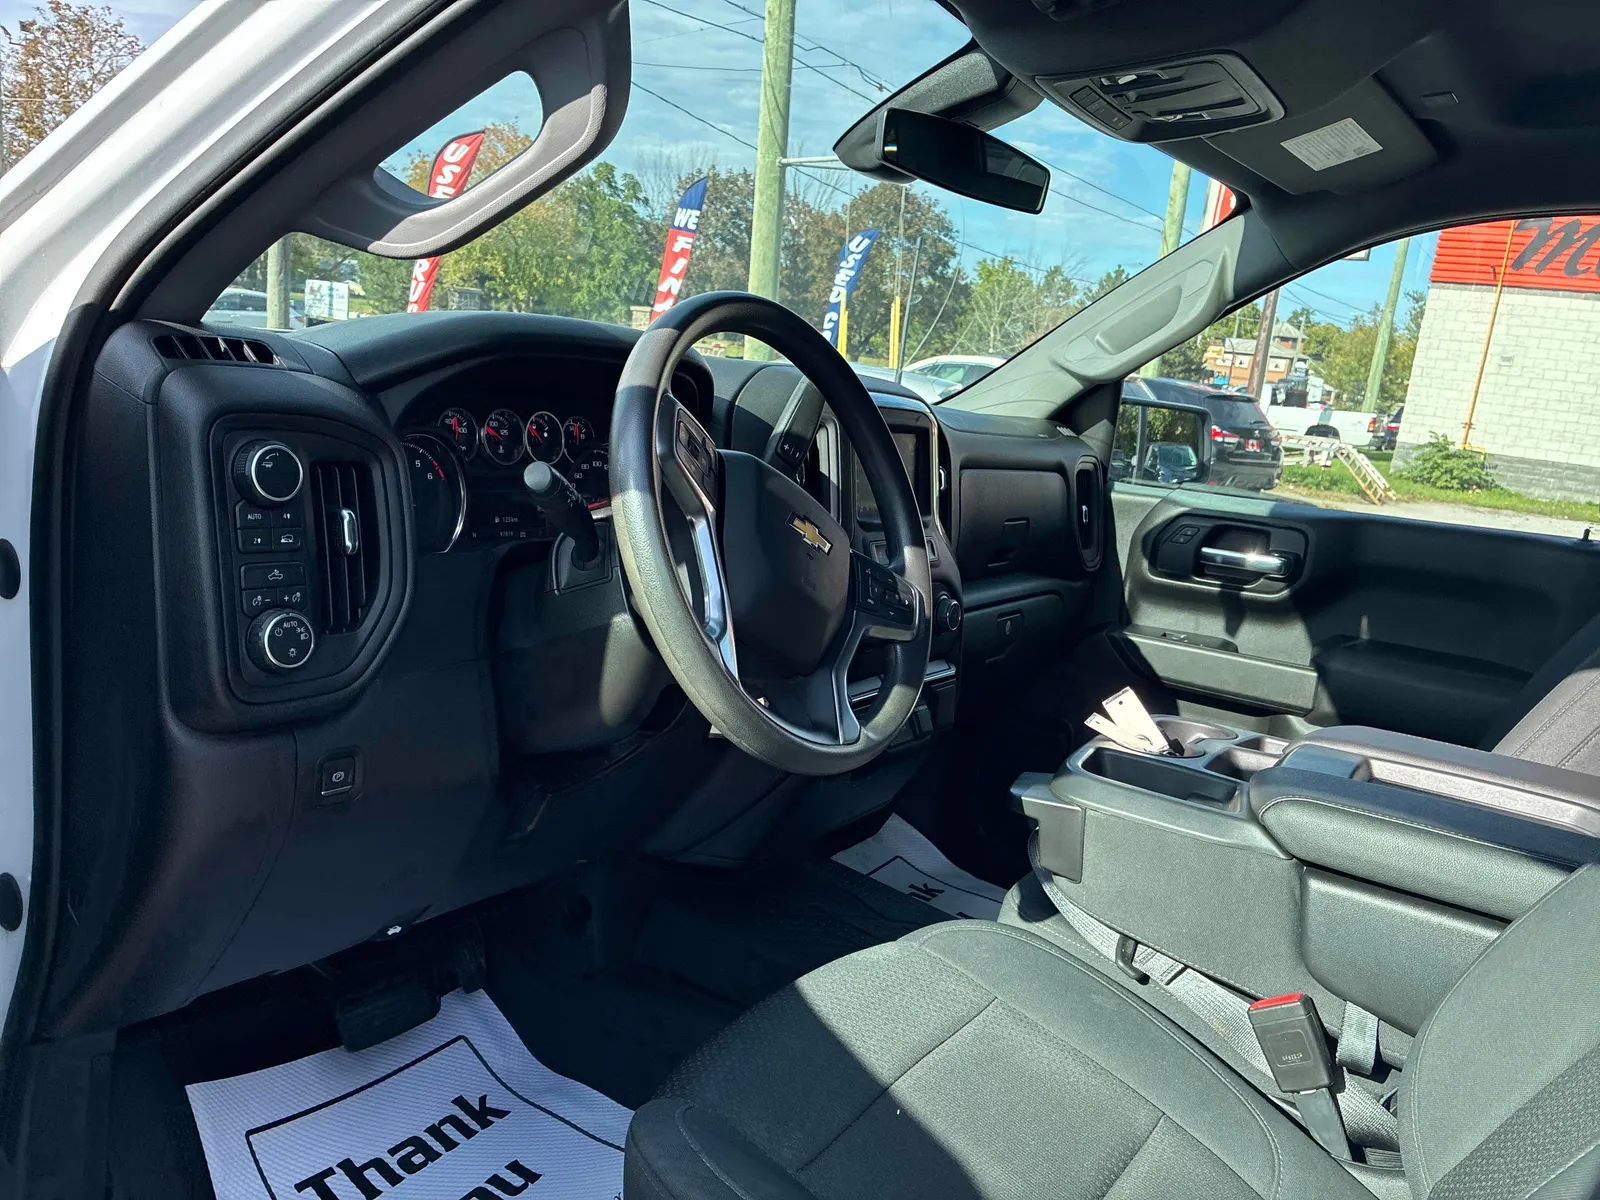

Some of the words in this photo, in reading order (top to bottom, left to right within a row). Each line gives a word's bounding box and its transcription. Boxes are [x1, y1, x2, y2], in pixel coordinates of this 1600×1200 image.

[431, 142, 469, 199] USE
[673, 207, 700, 230] WE
[829, 235, 871, 304] USED
[415, 460, 421, 468] 5
[294, 1095, 512, 1200] Thank
